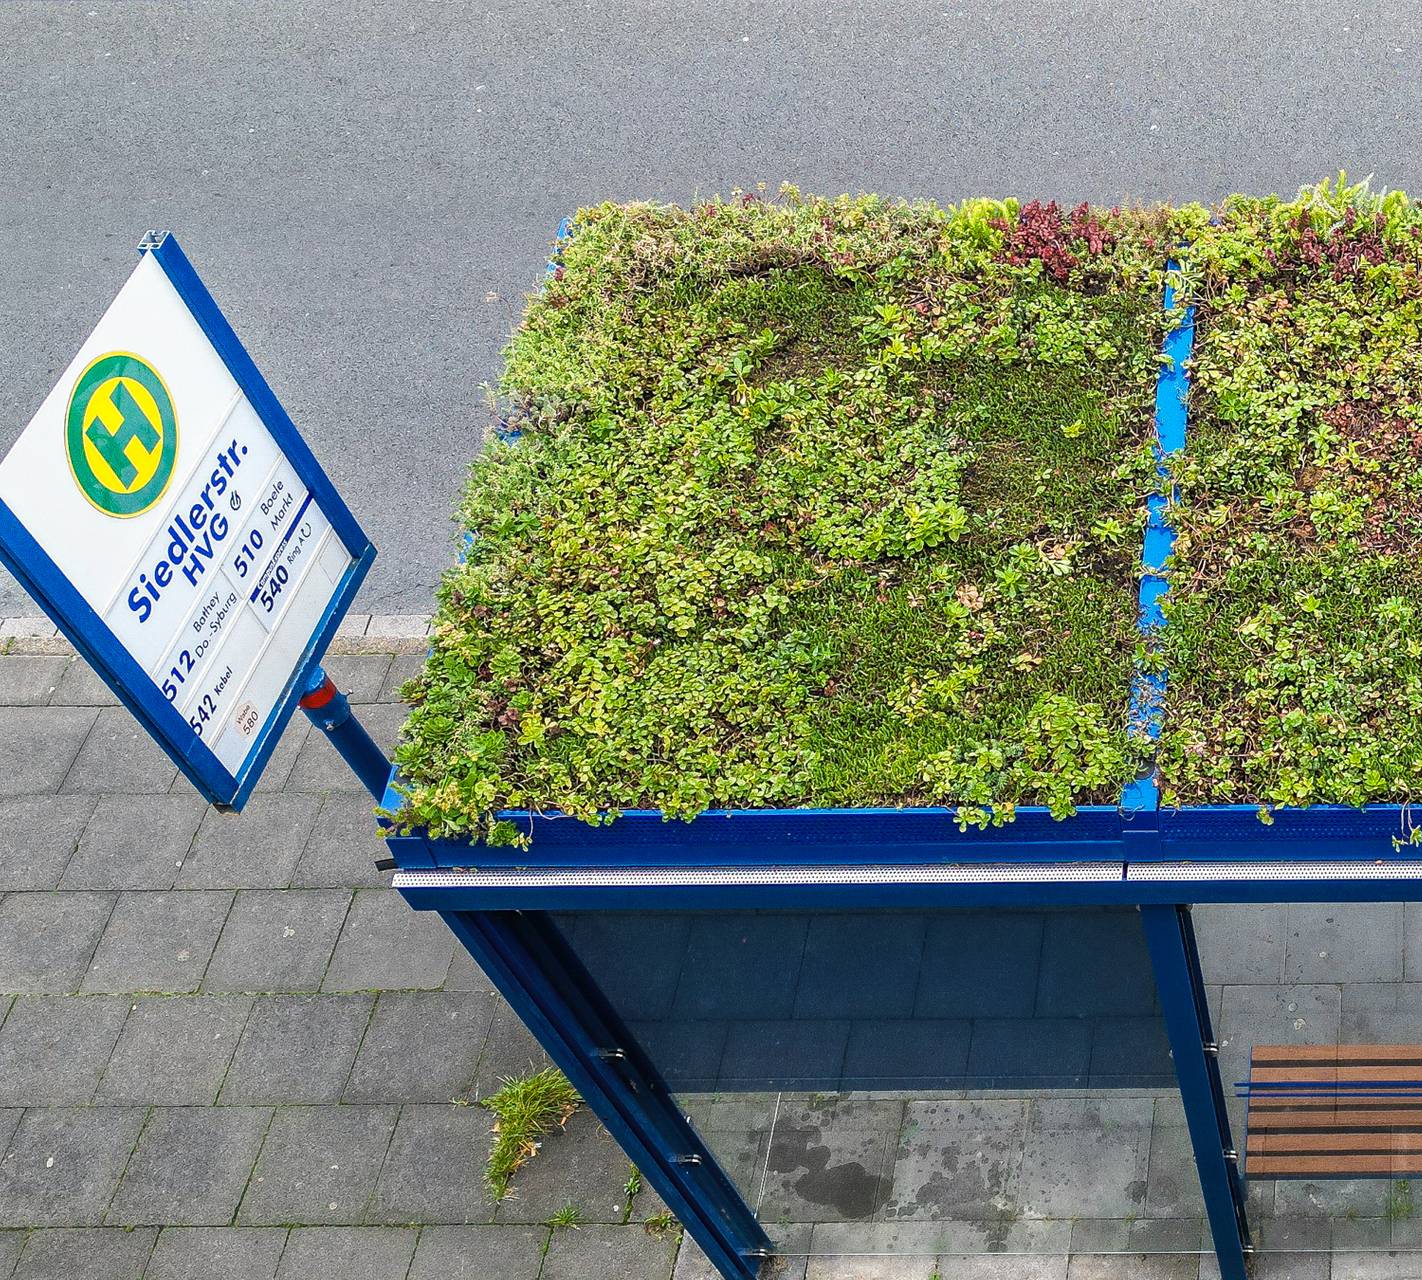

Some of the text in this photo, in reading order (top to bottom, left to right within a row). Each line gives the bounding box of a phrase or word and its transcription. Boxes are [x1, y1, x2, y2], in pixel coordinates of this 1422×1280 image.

[84, 380, 161, 490] H
[261, 481, 283, 515] Boele
[271, 493, 293, 530] Markt
[128, 440, 247, 623] Siedlerstr.
[182, 513, 228, 587] HVG
[234, 529, 263, 577] 510
[261, 565, 288, 612] 540
[287, 546, 301, 564] Ring
[193, 592, 219, 632] Bathey
[162, 650, 195, 702] 512
[190, 666, 232, 736] 542 Kabel
[243, 711, 258, 735] 580
